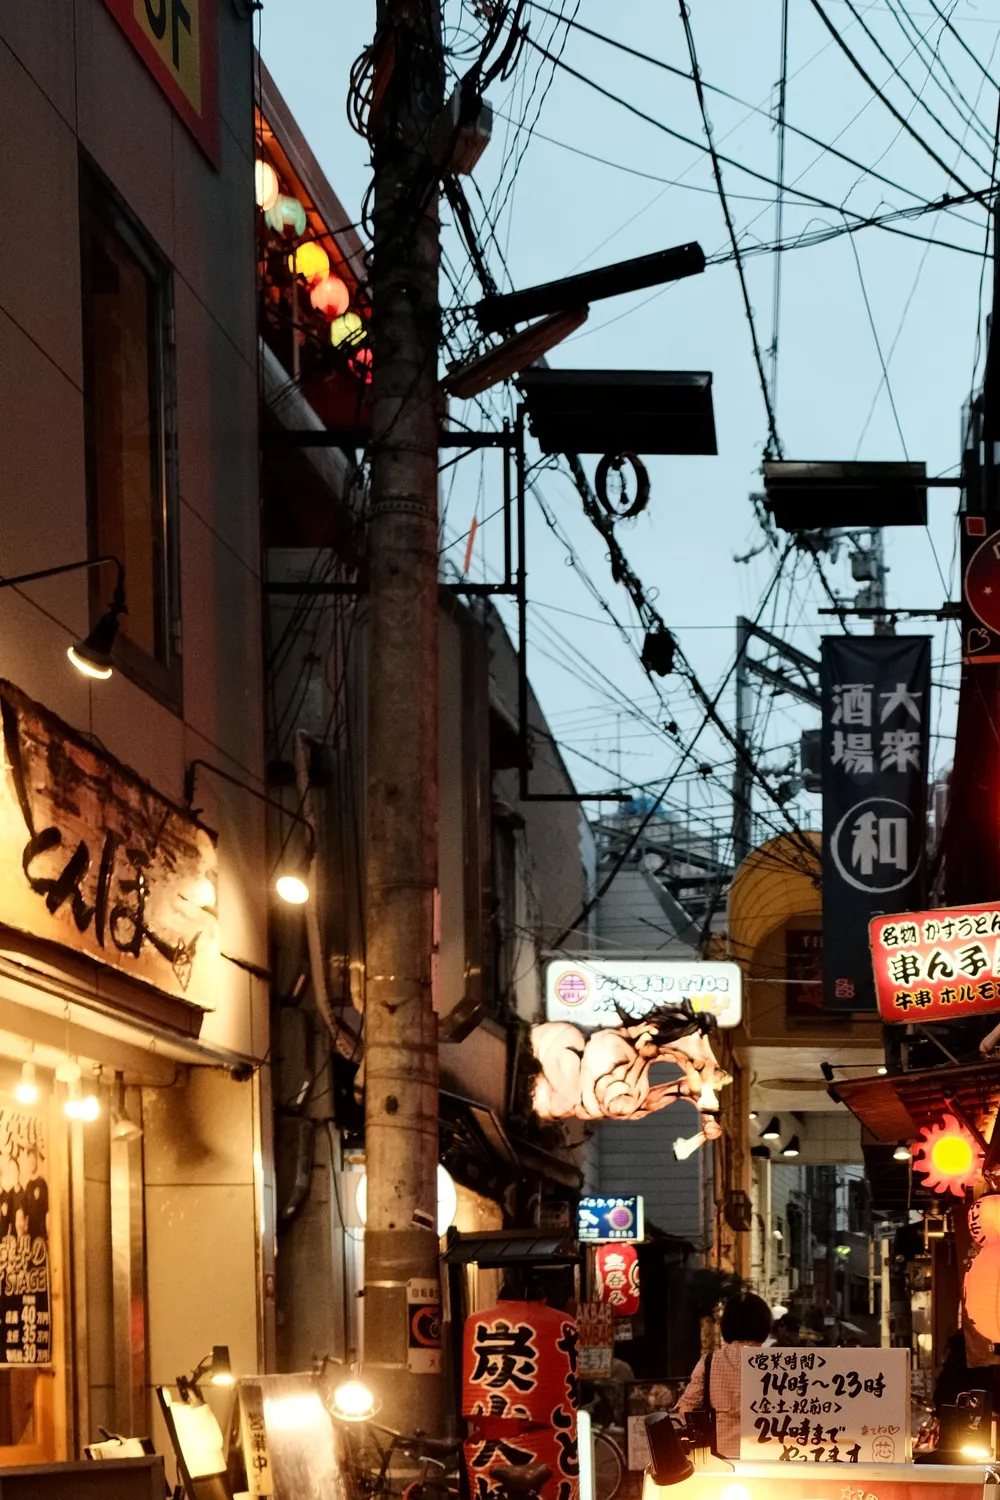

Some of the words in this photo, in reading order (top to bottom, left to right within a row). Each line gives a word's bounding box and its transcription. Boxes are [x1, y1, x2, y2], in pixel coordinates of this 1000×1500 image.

[830, 683, 875, 774] 酒場
[879, 683, 922, 773] 大衆
[851, 811, 908, 875] 和
[883, 924, 918, 947] 名物
[890, 944, 989, 985] 串ん子
[894, 989, 931, 1011] 牛串
[754, 1414, 846, 1446] 24時まで
[778, 1444, 862, 1463] やってます
